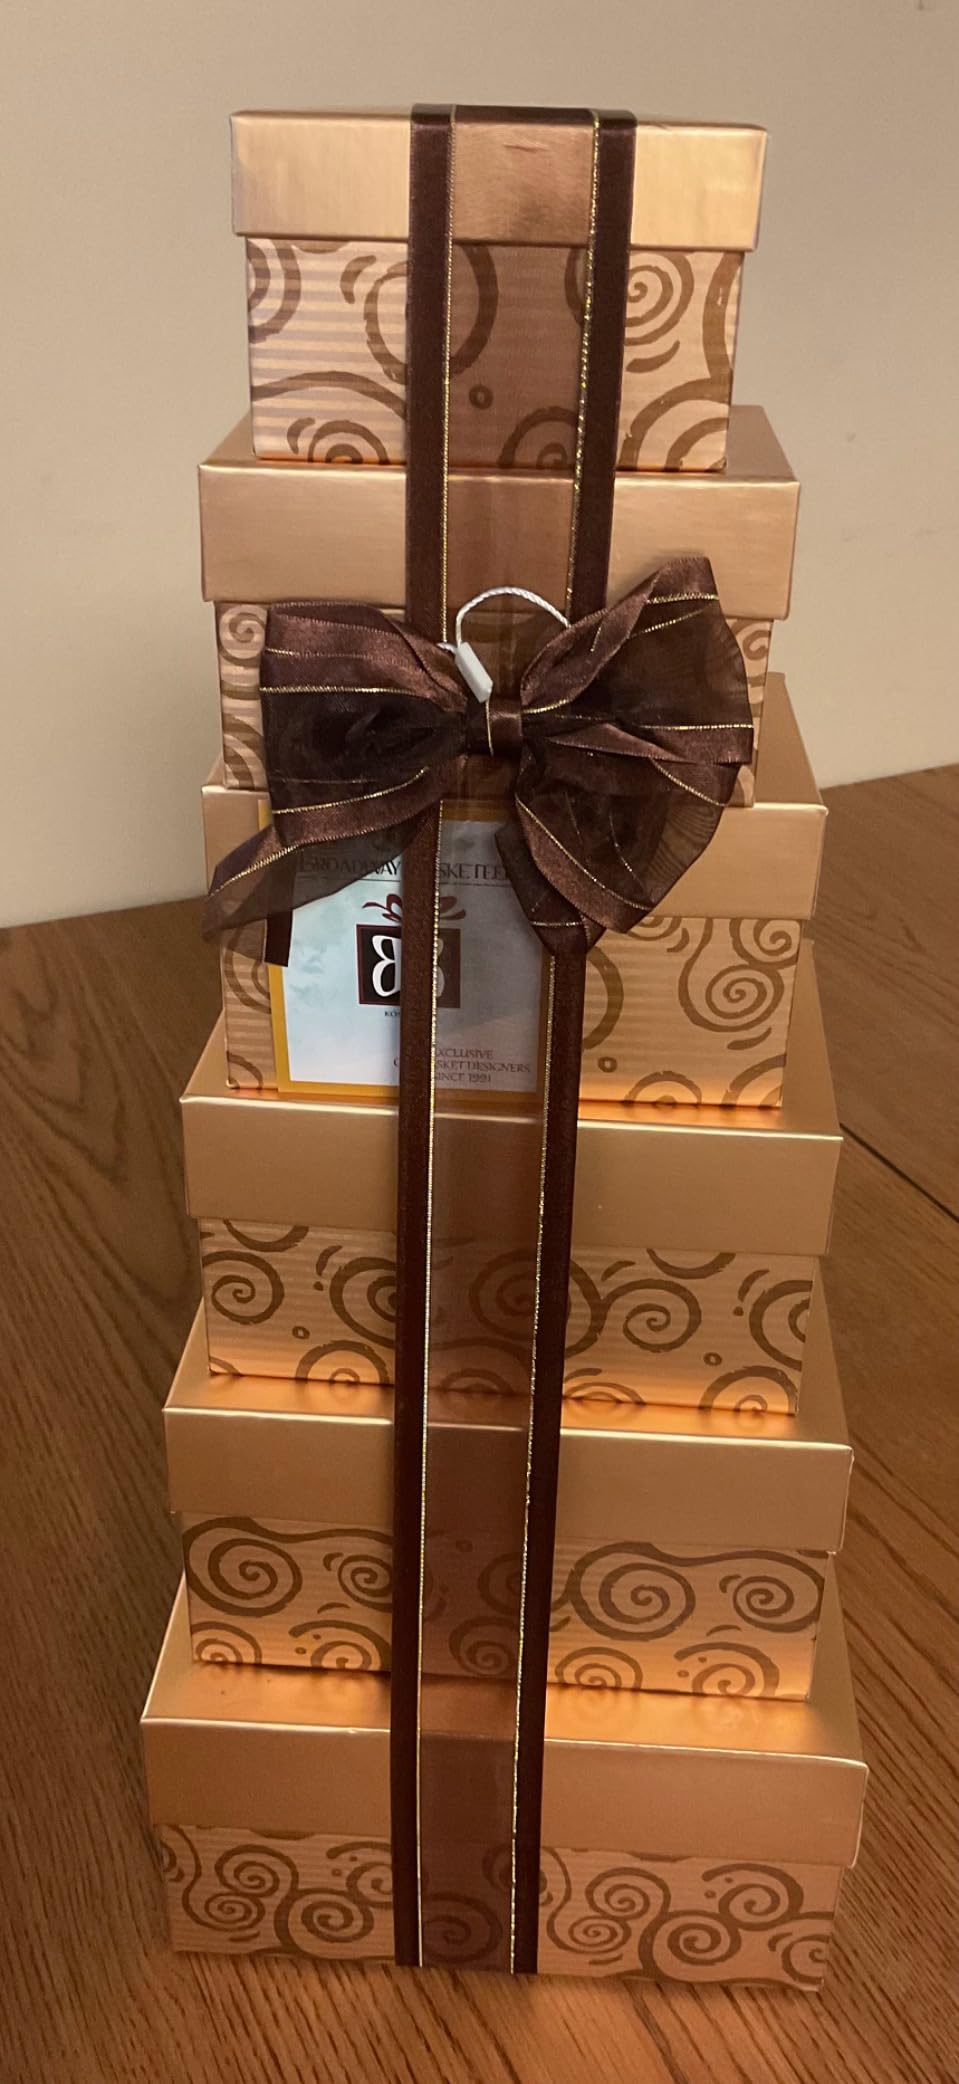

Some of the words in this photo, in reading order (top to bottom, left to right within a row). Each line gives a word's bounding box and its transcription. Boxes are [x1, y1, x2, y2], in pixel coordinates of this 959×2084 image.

[436, 1047, 494, 1060] XCLUSIVE
[436, 1059, 465, 1071] SKET
[468, 1061, 531, 1073] DESIGNERS
[435, 1071, 465, 1081] INCE
[468, 1072, 492, 1083] 1991
